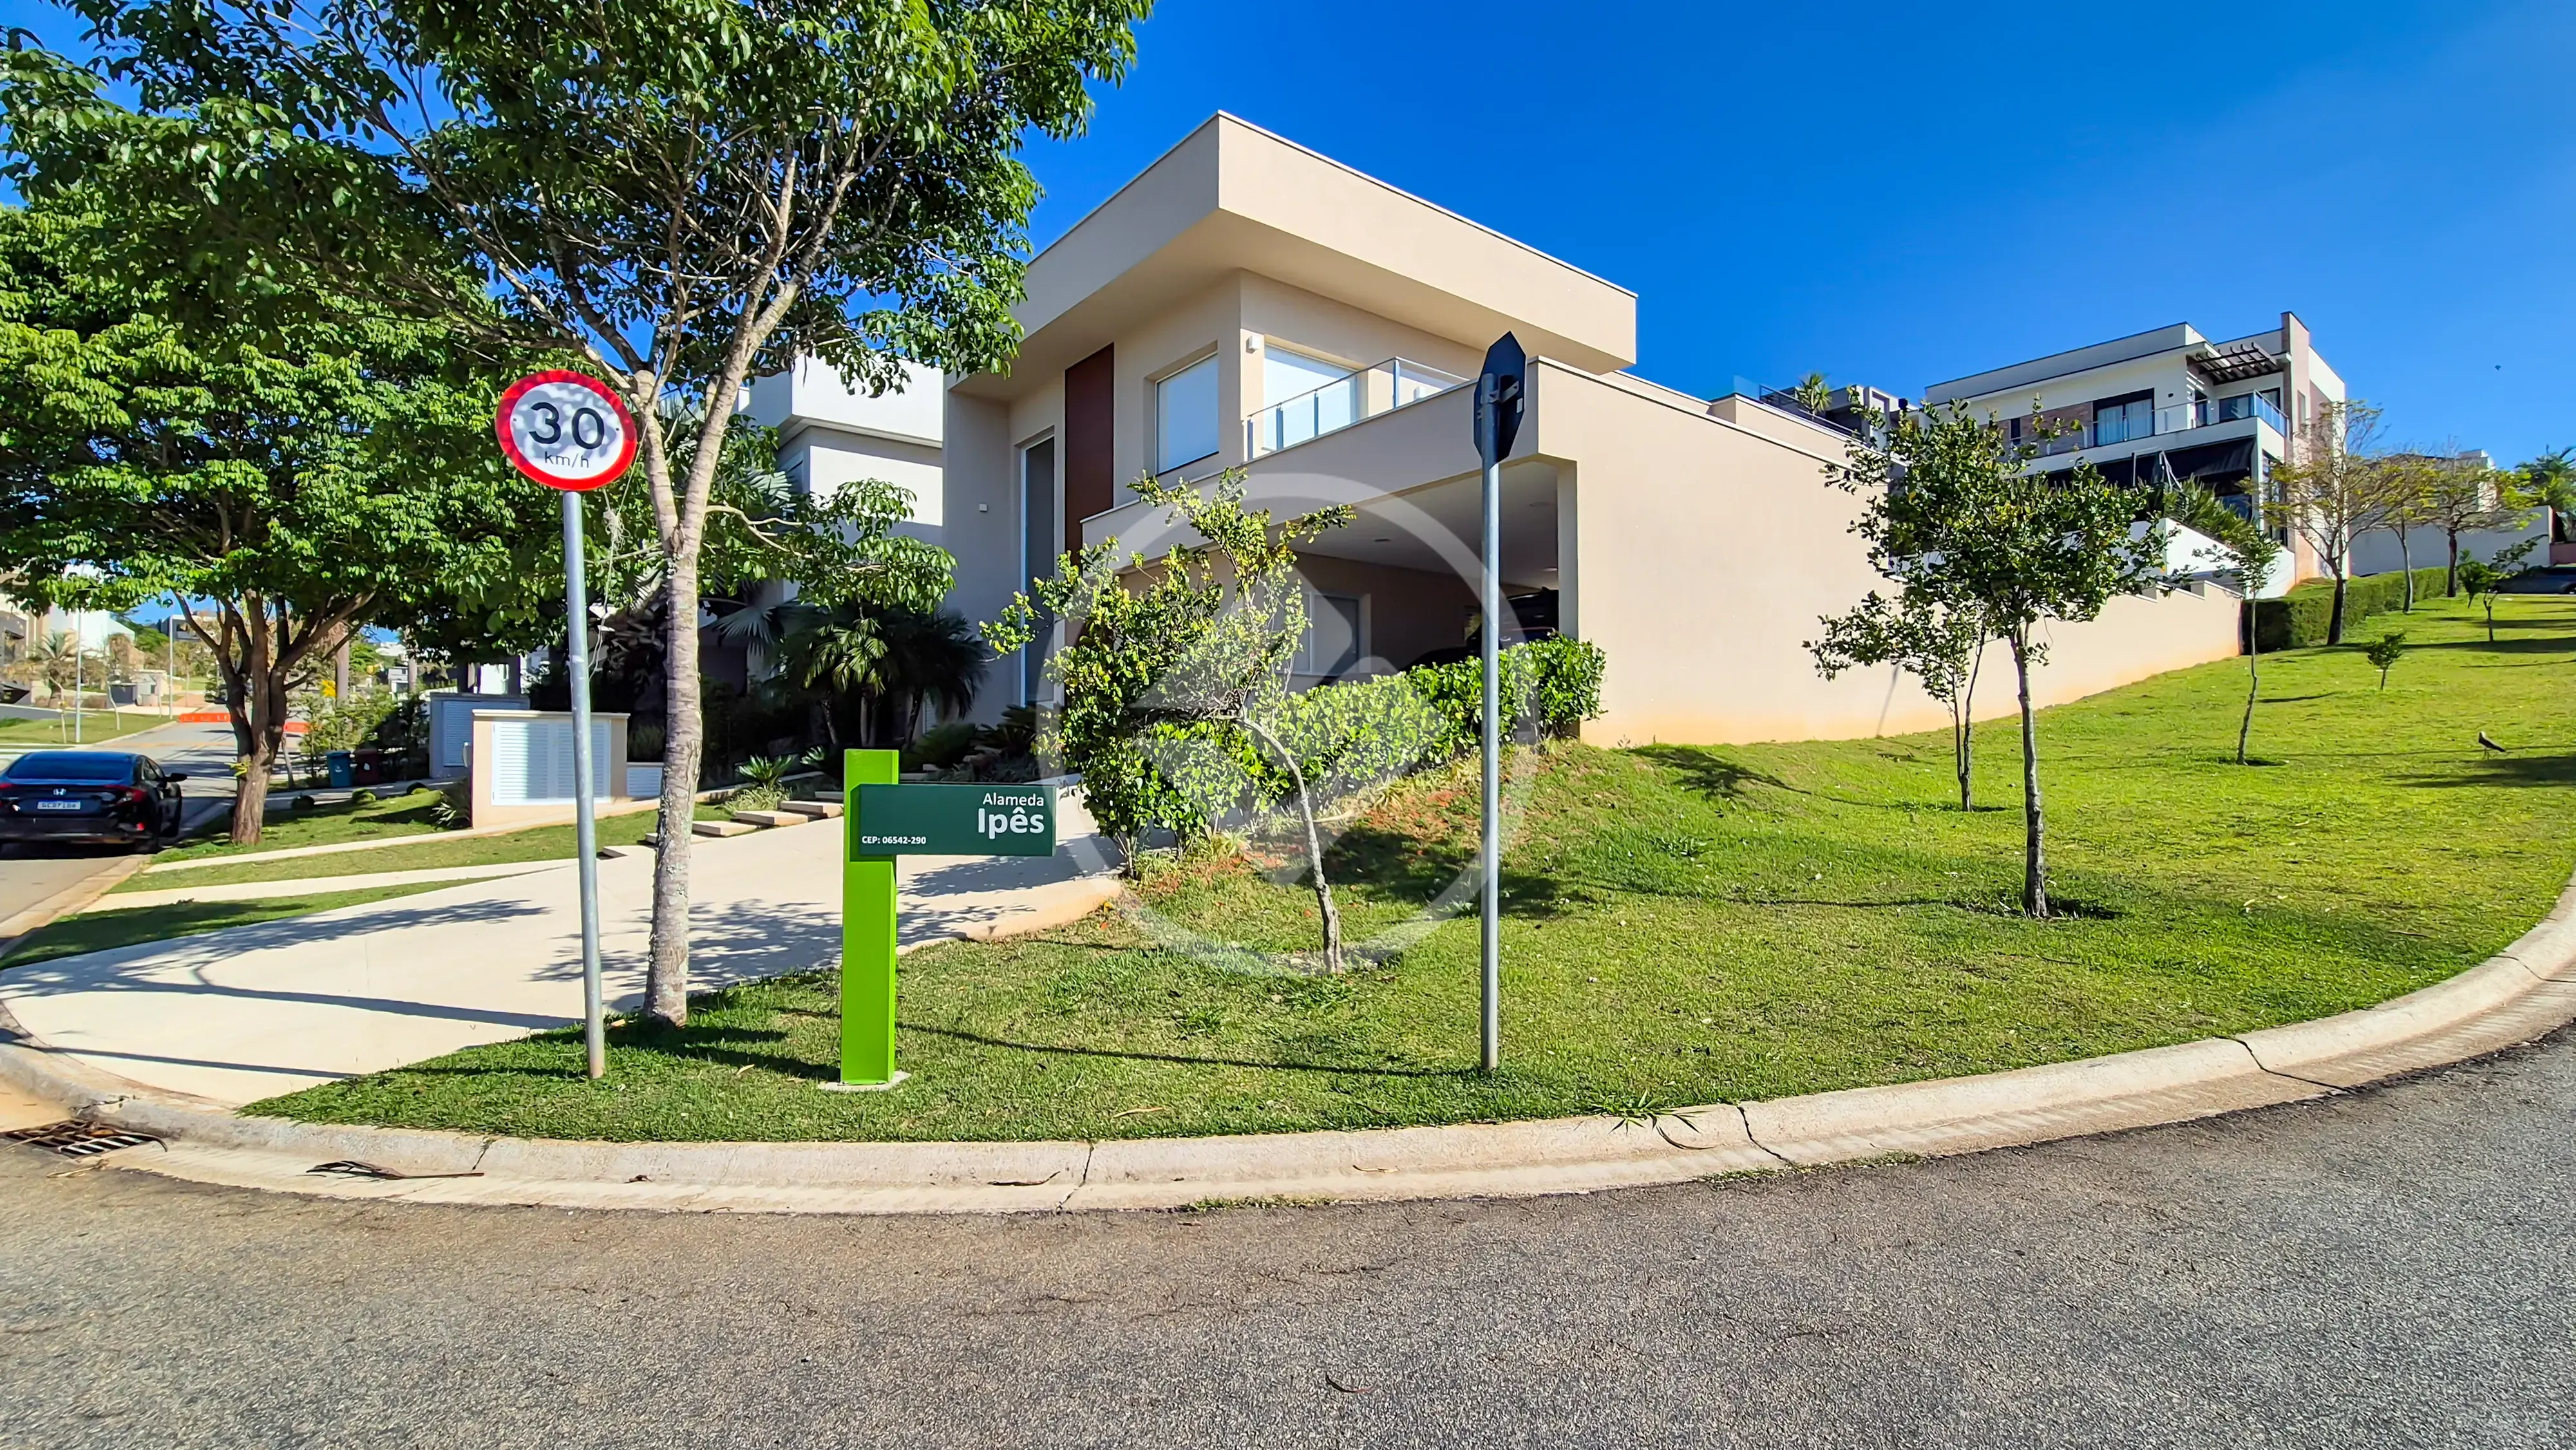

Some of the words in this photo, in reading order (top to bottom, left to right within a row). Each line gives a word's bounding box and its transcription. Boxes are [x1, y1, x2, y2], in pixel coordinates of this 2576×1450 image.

[529, 402, 605, 449] 30
[544, 451, 589, 468] km/h
[982, 792, 1044, 807] Alameda
[978, 806, 1045, 840] Ipês
[862, 836, 880, 844] CEP:
[882, 836, 927, 845] 06542-290
